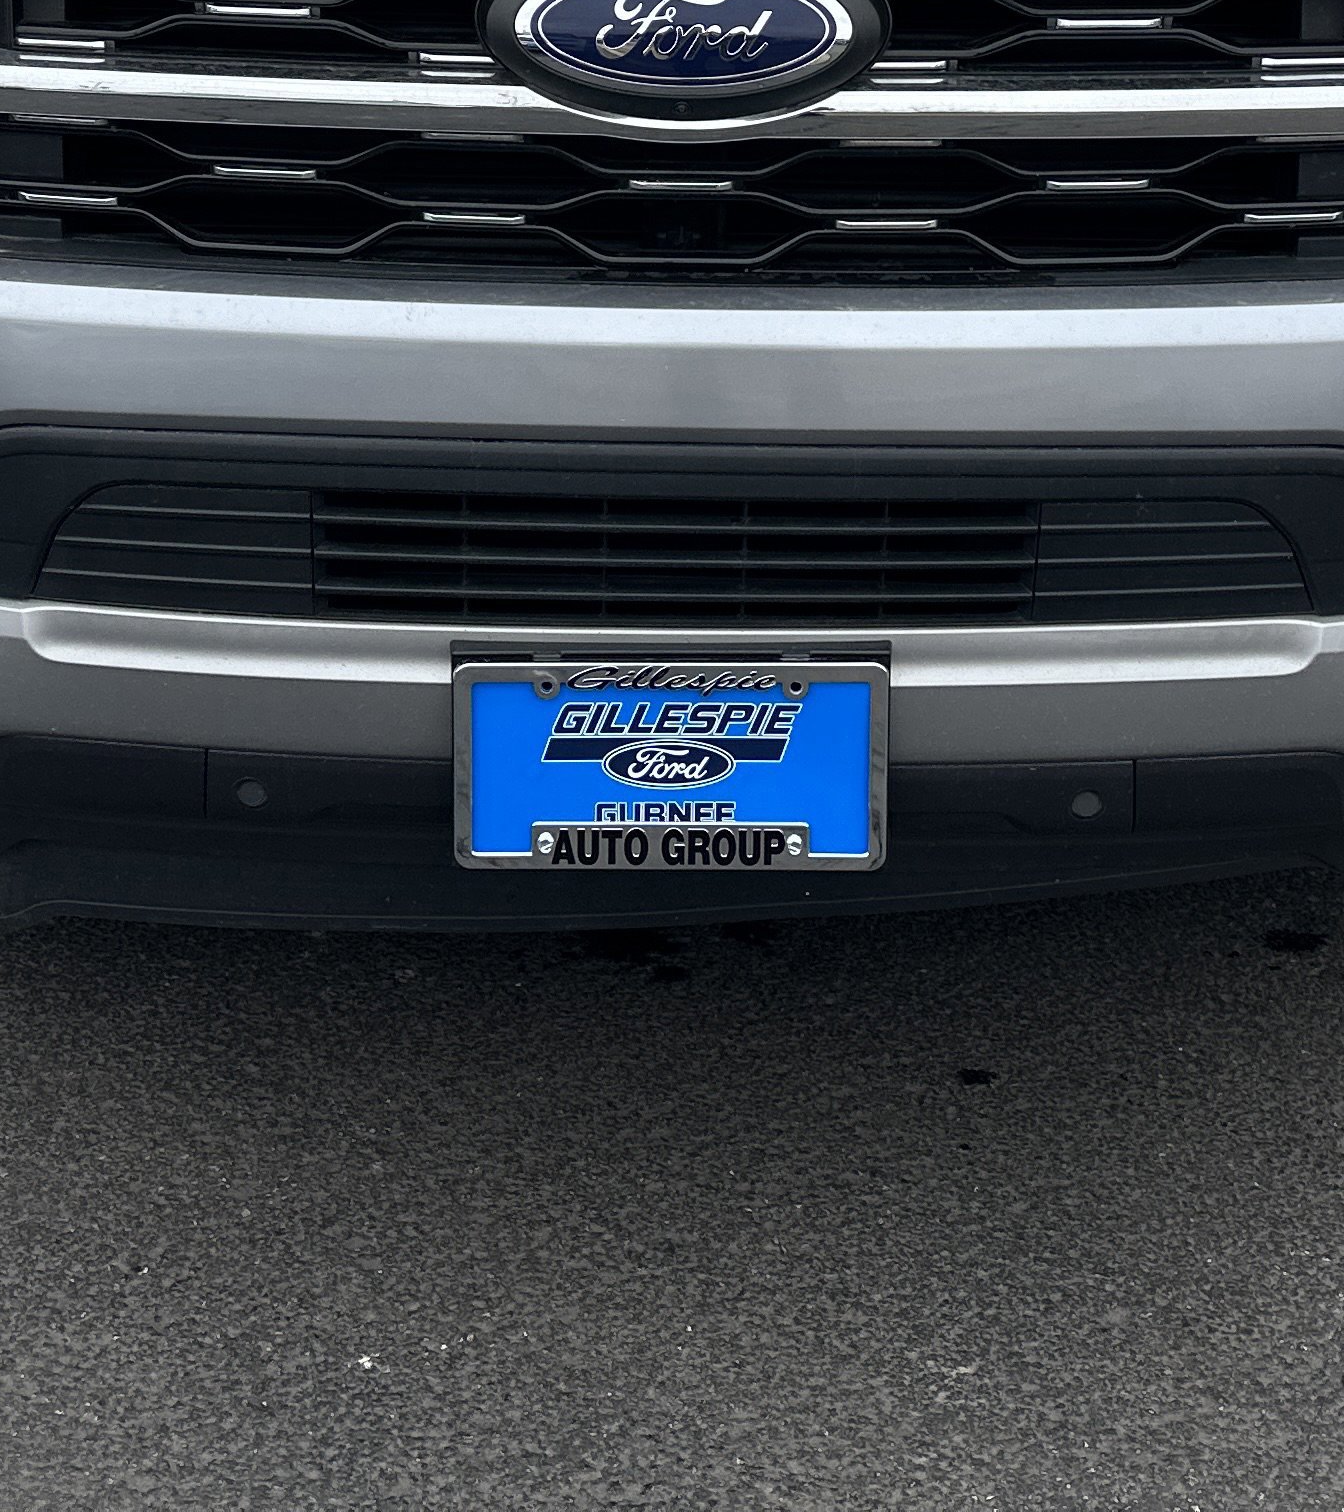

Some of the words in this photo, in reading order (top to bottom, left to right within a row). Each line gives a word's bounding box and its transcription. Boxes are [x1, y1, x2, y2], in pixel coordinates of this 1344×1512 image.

[567, 665, 777, 697] Gillespie
[552, 702, 803, 736] GILLESPIE
[627, 747, 710, 780] Ford
[594, 801, 737, 823] GURNEE
[552, 827, 649, 866] AUTO
[661, 827, 786, 867] GROUP
